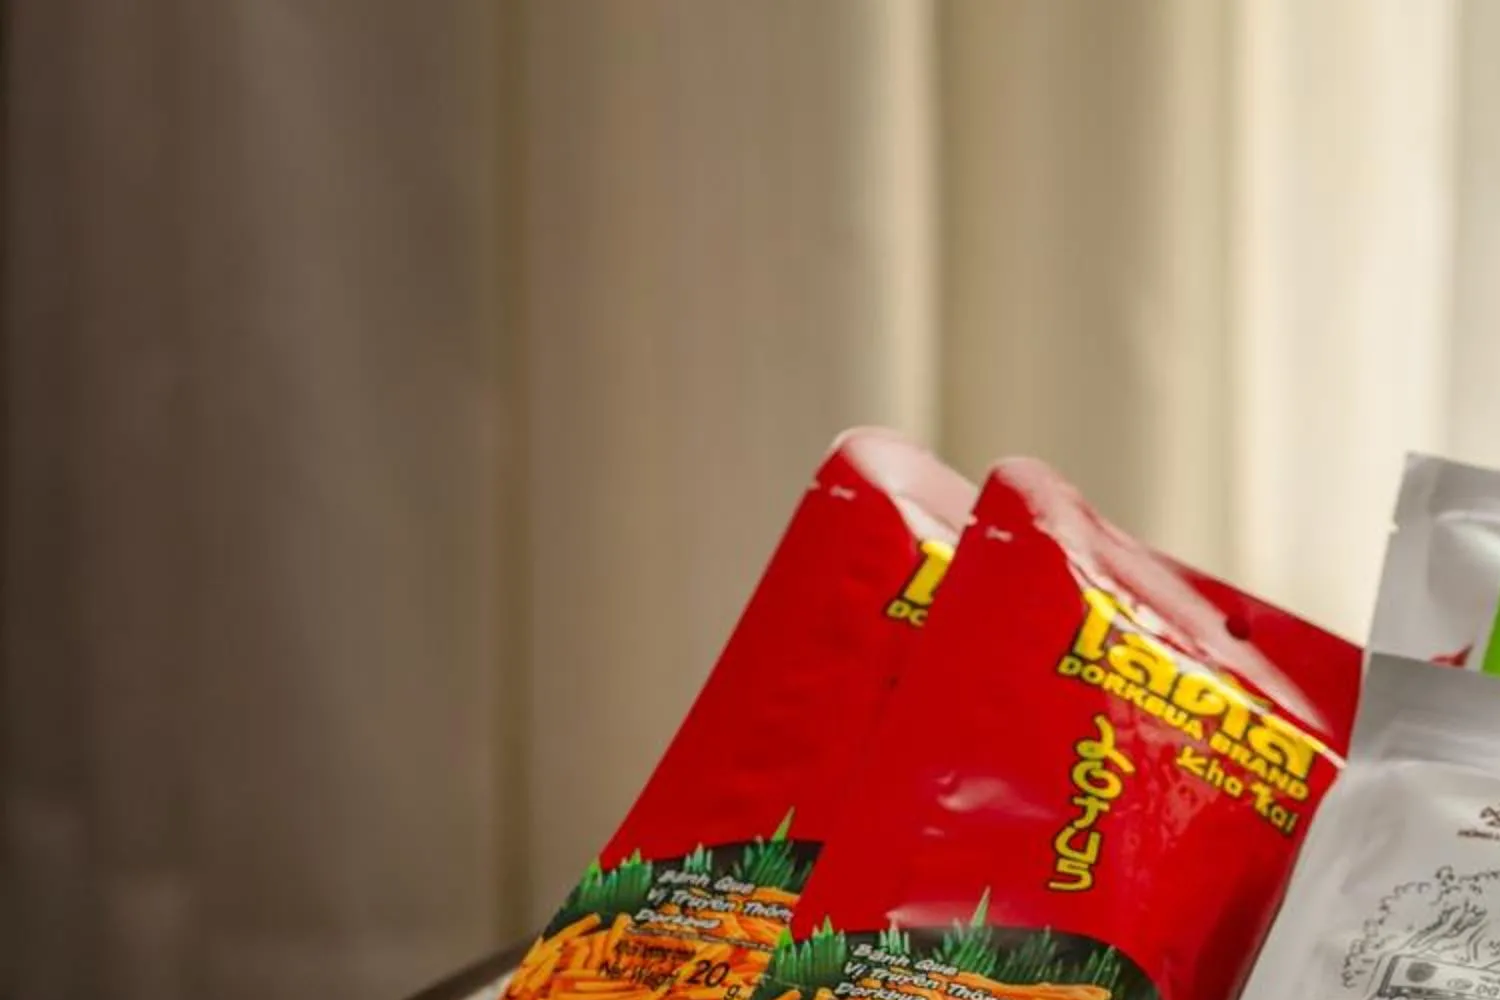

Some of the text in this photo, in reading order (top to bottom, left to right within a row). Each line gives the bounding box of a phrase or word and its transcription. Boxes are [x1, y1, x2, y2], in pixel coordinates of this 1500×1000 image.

[1057, 655, 1308, 800] DORKBUA BRAND
[1176, 746, 1244, 797] Kha
[687, 959, 732, 988] 20
